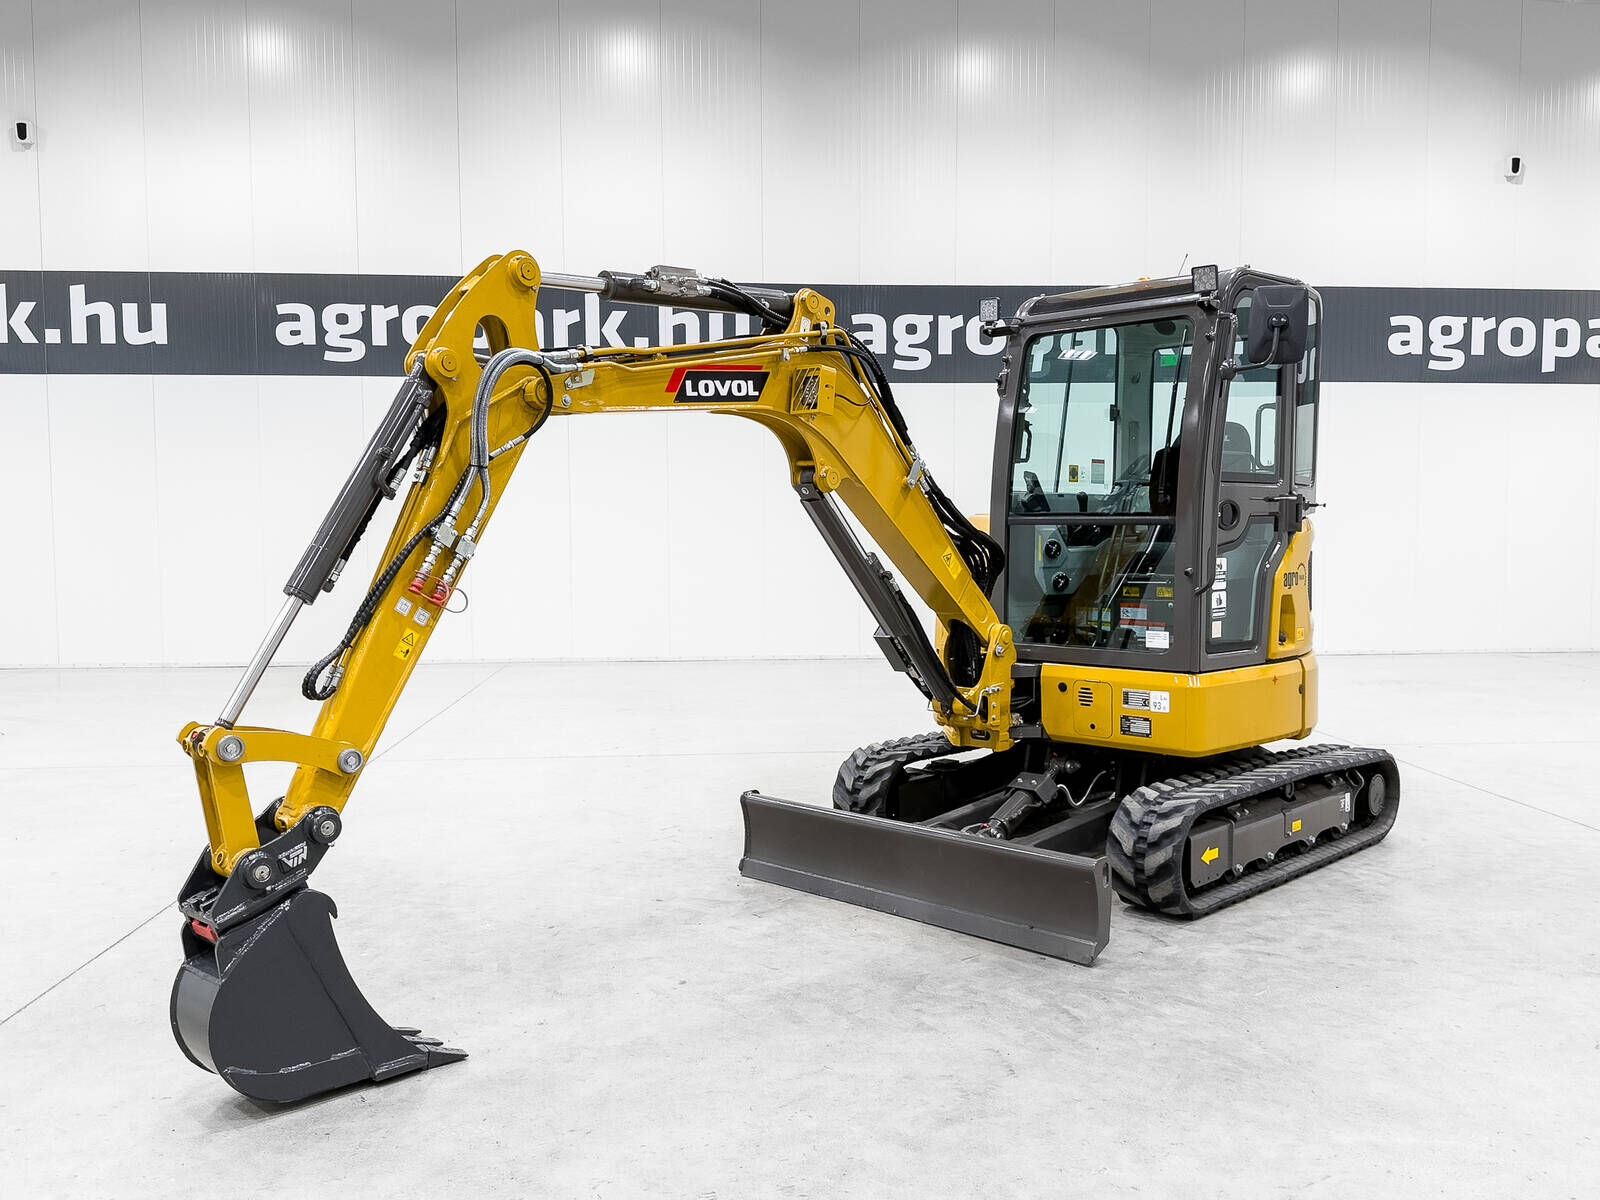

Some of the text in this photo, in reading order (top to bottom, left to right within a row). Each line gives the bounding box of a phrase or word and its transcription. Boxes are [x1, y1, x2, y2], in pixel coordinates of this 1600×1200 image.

[0, 283, 168, 345] k.hu
[685, 379, 760, 397] LOVOL
[1283, 571, 1299, 590] agro
[1152, 701, 1162, 711] 93
